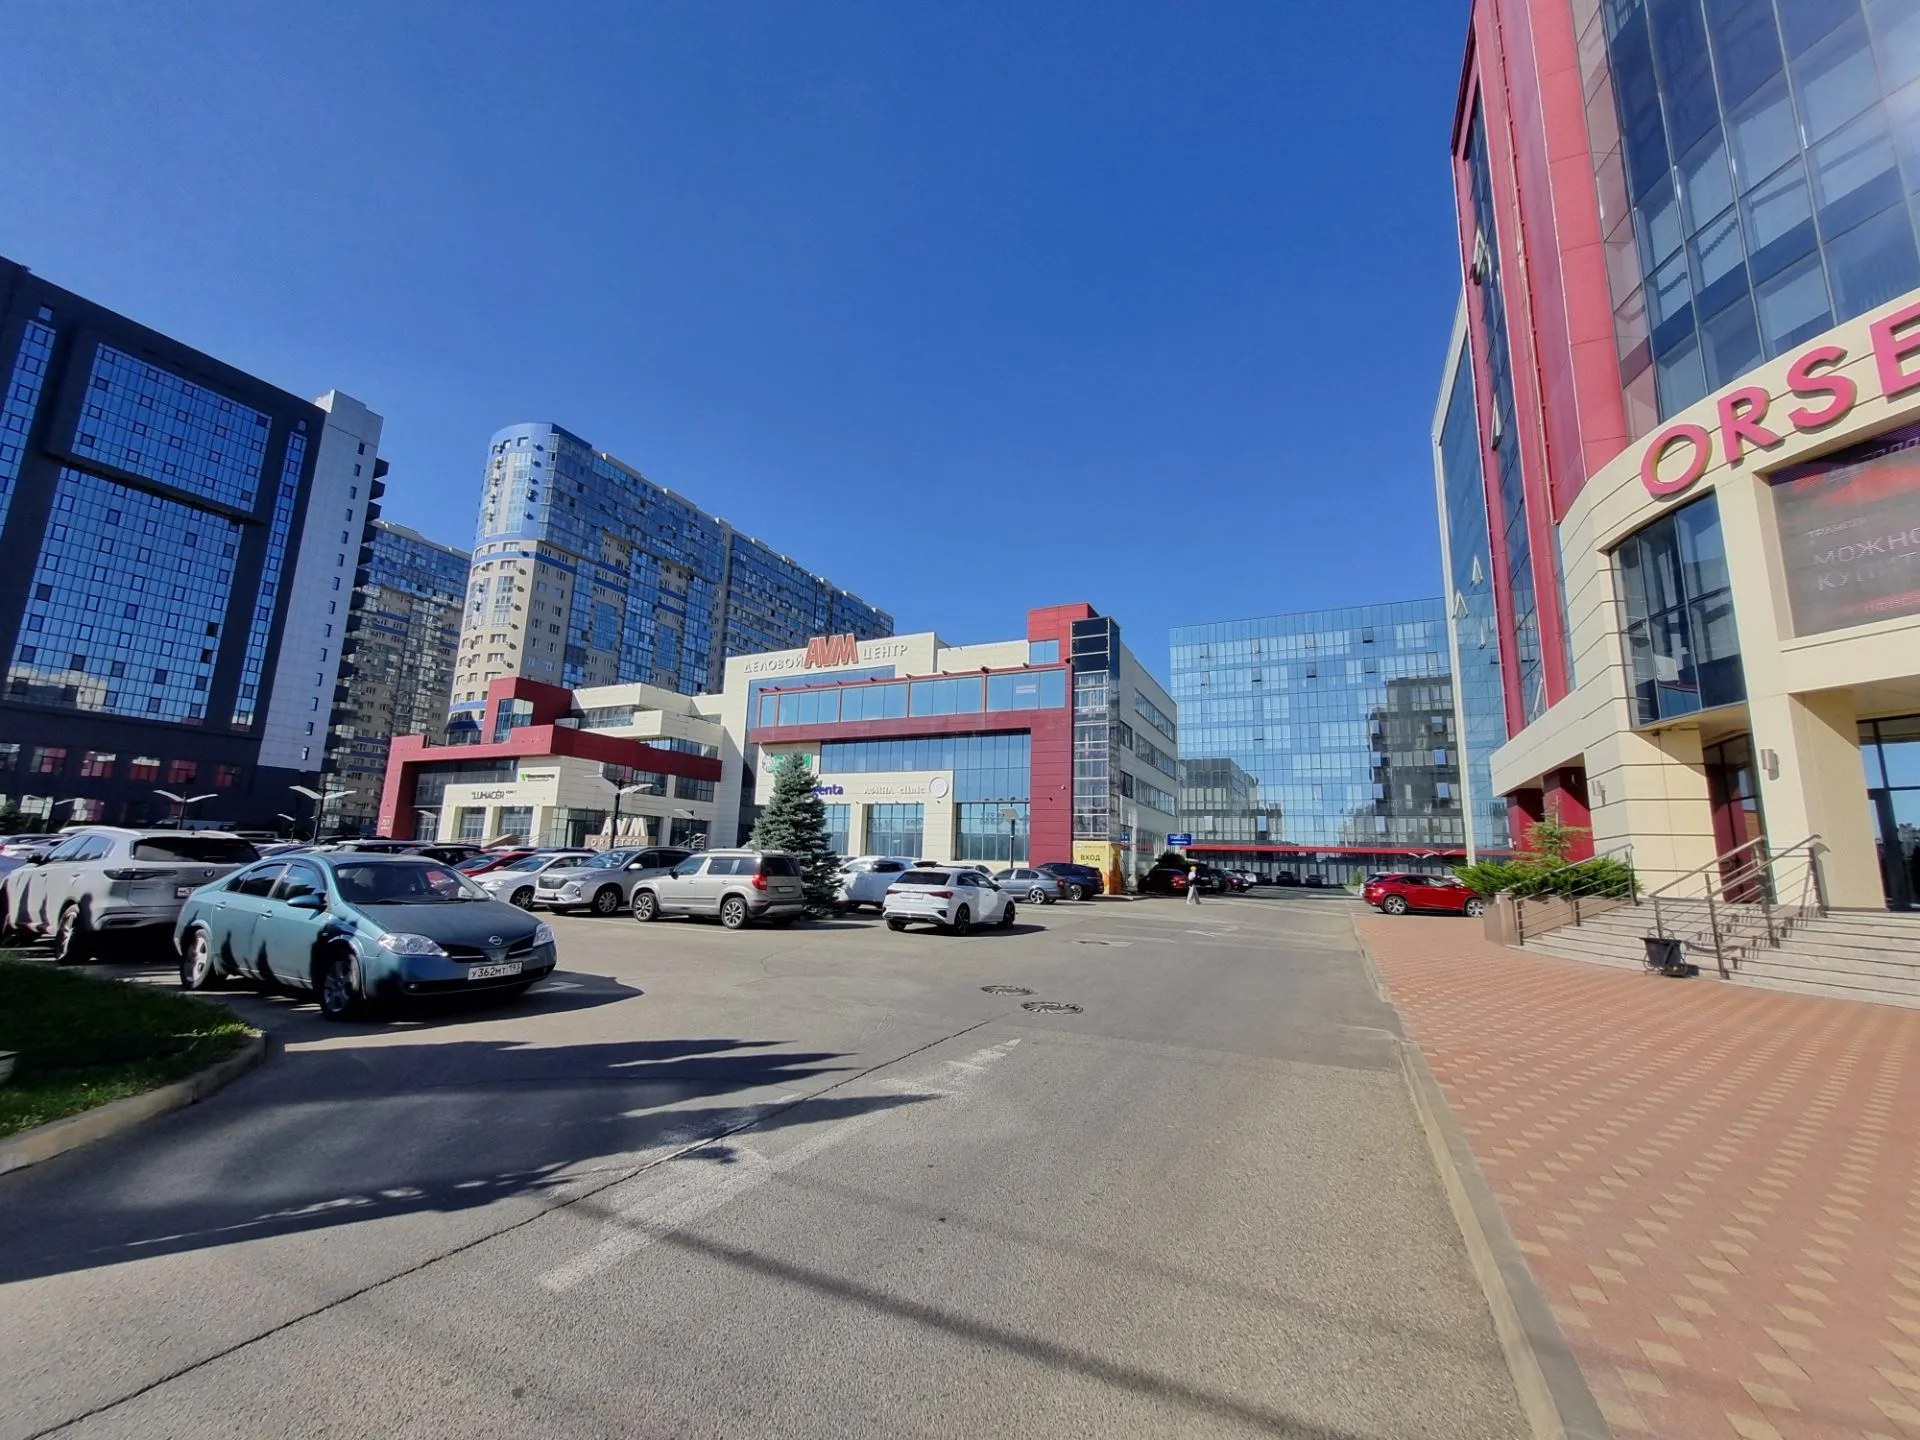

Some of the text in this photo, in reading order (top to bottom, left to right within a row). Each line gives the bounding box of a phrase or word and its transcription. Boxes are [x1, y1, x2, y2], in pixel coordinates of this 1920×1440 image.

[744, 633, 908, 673] ДЕЛОВОЙ AVM ЦЕНТР
[601, 817, 648, 837] AVM
[1080, 854, 1101, 862] ВХОД
